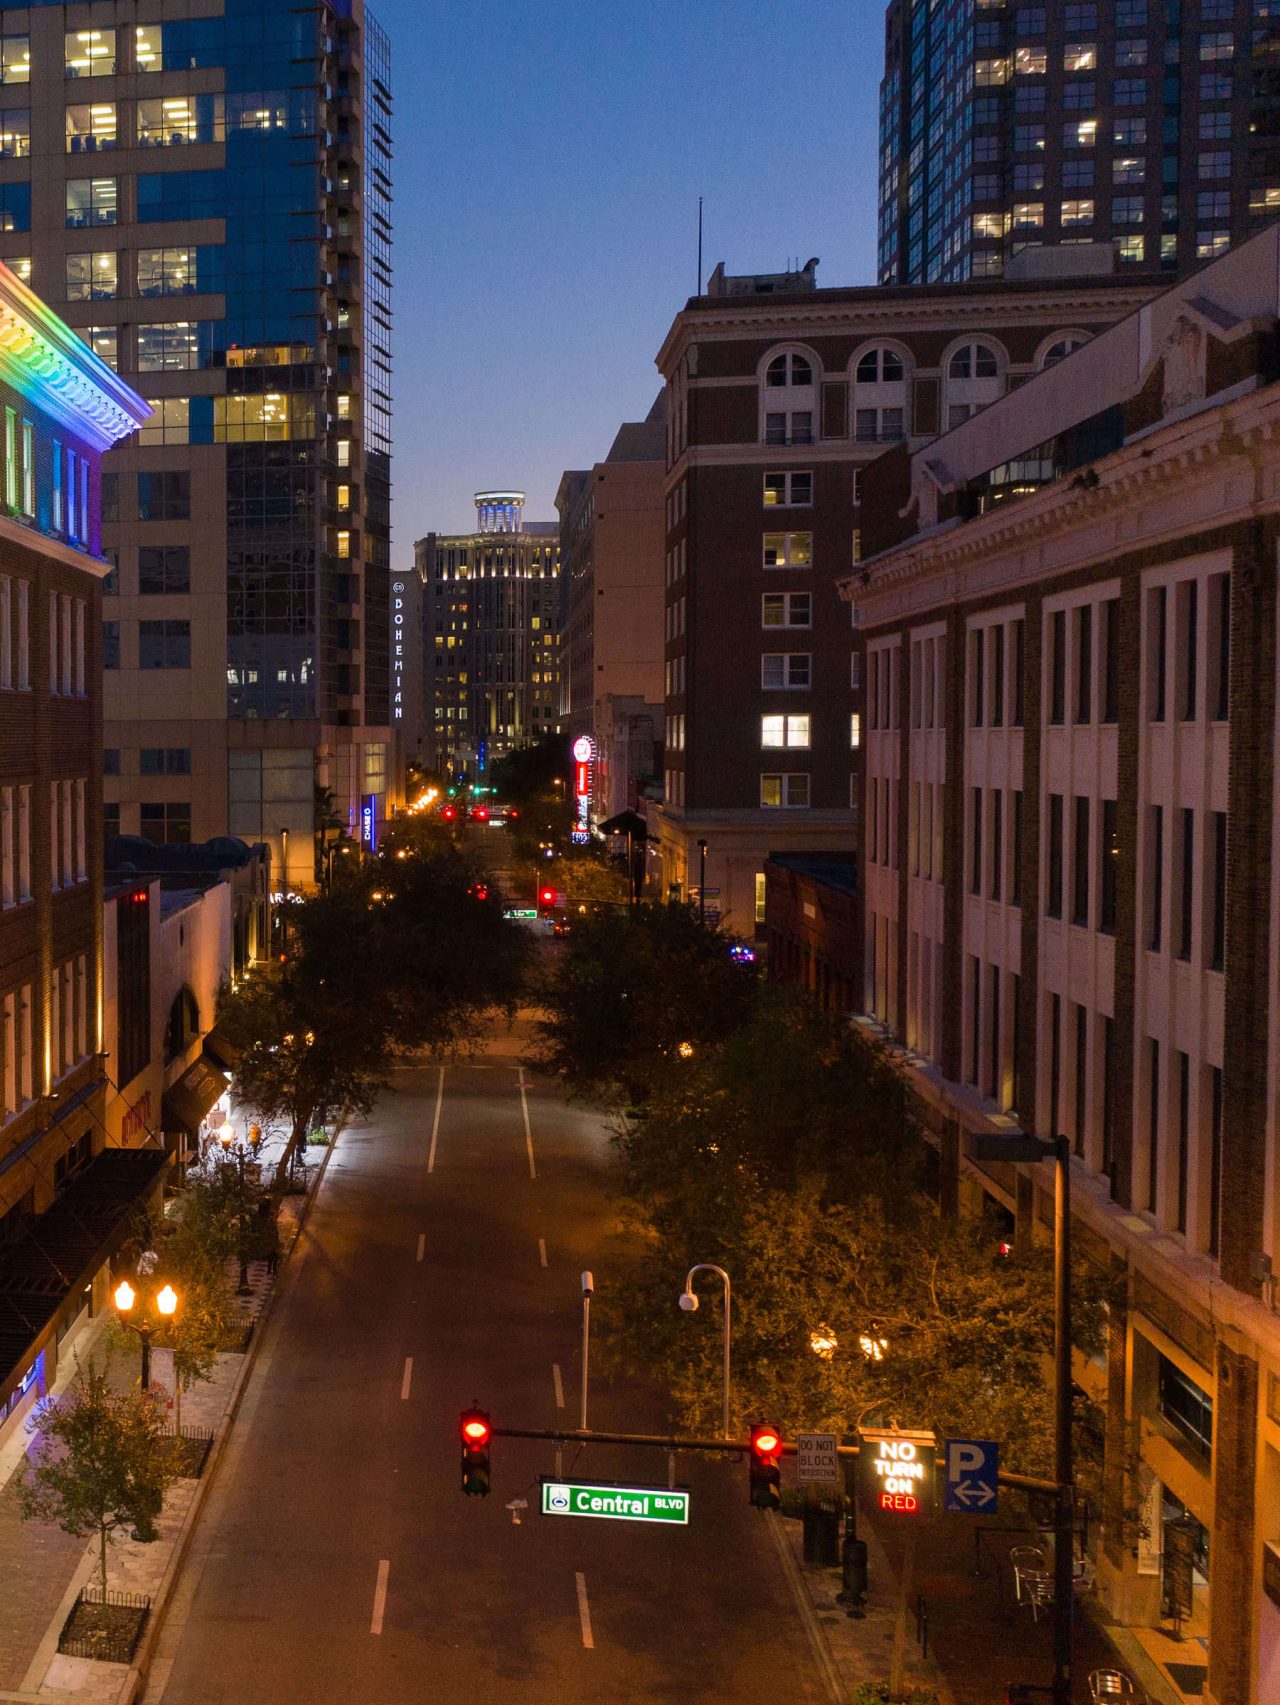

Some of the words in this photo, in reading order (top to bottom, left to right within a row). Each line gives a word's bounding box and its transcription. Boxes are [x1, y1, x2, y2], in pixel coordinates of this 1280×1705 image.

[394, 598, 403, 719] BOHEMIAN
[800, 1440, 813, 1451] DO
[815, 1440, 834, 1451] NOT
[879, 1441, 917, 1460] NO
[800, 1455, 834, 1466] BLOCK
[874, 1460, 923, 1478] TURN
[949, 1443, 985, 1482] P
[885, 1478, 913, 1493] ON
[576, 1491, 649, 1515] Central
[654, 1497, 684, 1510] BLVD
[882, 1495, 916, 1510] RED
